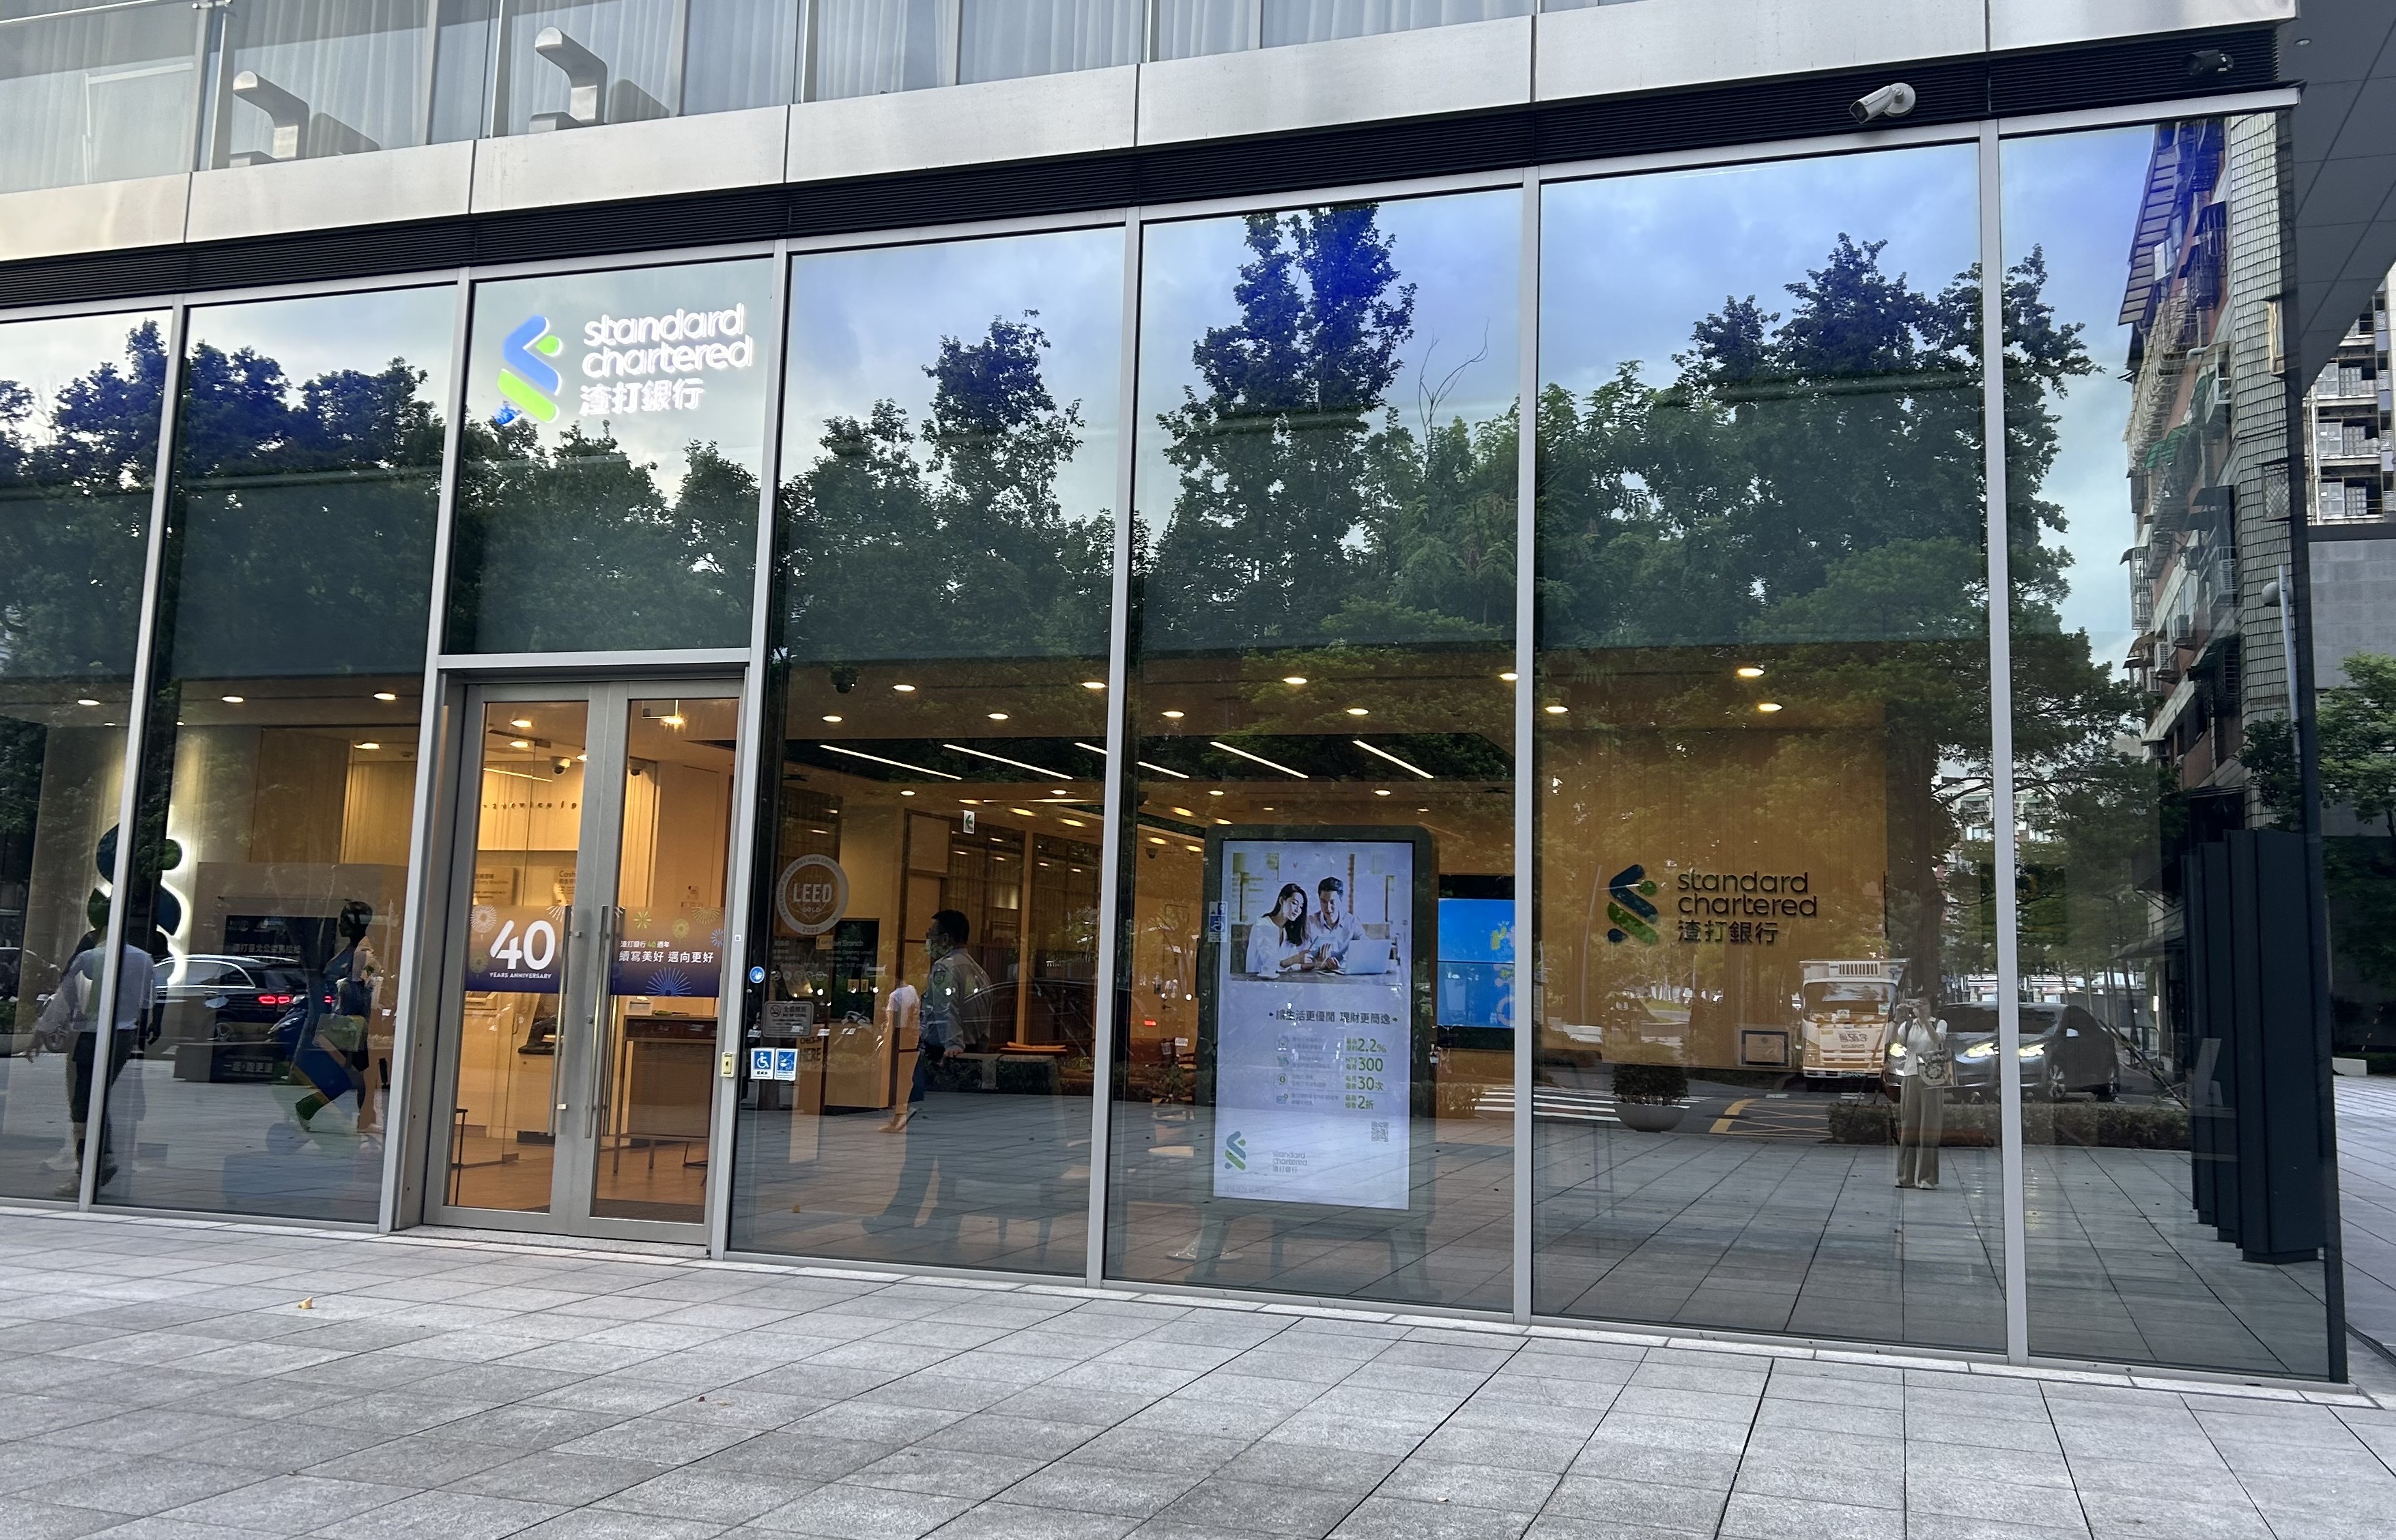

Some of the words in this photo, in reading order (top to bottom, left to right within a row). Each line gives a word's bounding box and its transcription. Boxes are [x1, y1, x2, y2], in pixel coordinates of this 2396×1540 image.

[584, 302, 744, 346] standard
[582, 334, 753, 378] chartered
[579, 377, 704, 416] 渣打銀行
[793, 883, 833, 902] LEED
[1677, 870, 1809, 894] standard
[1677, 893, 1818, 917] chartered
[1677, 919, 1779, 945] 渣打銀行
[489, 920, 556, 970] 40
[618, 950, 664, 962] 續寫美好
[668, 951, 714, 963] 邁向更好
[1358, 1038, 1387, 1053] 2.2%
[1358, 1057, 1384, 1072] 300
[1272, 1151, 1305, 1159] standard
[1272, 1158, 1308, 1166] chartered
